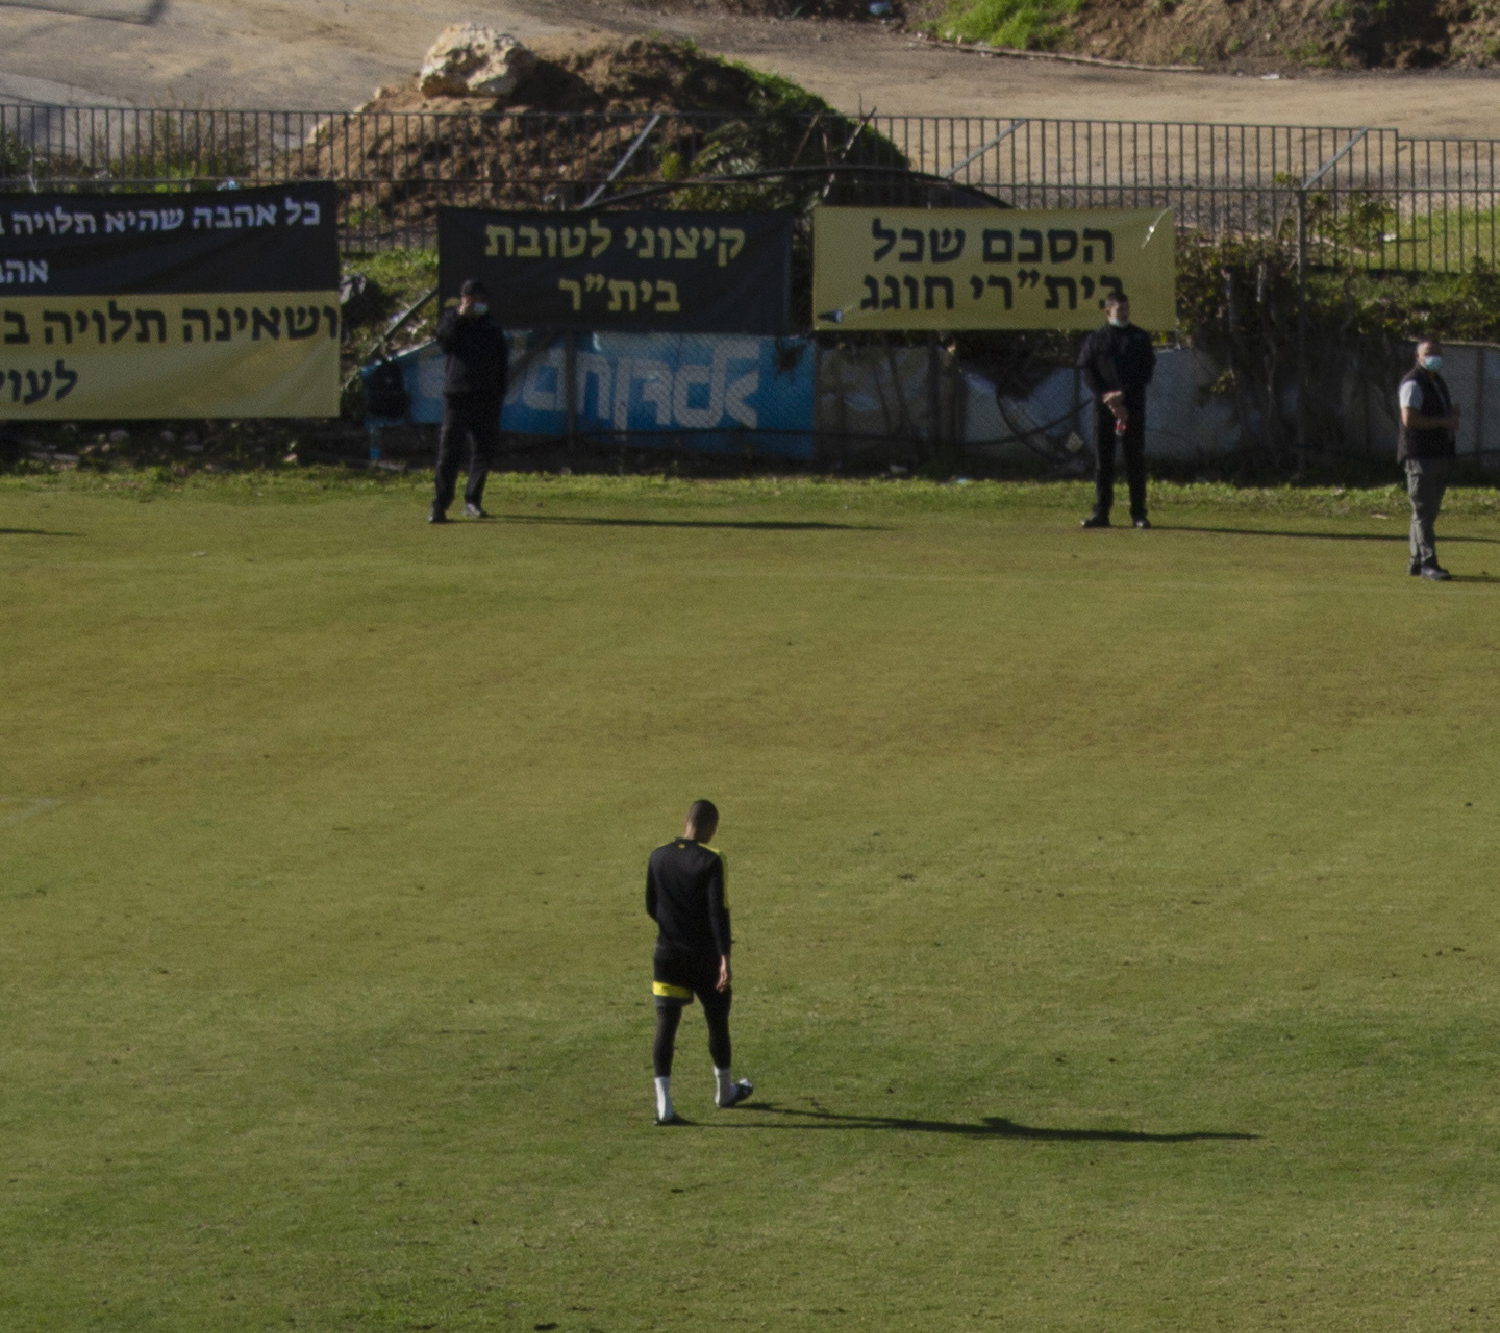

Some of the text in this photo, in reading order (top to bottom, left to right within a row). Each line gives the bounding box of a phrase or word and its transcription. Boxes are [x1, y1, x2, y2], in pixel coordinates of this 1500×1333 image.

[11, 205, 97, 235] תלויה
[104, 207, 185, 232] שהיא
[192, 203, 278, 229] אהבה
[285, 197, 321, 226] כל
[484, 217, 746, 267] קיצוני לטובת
[871, 218, 1115, 263] הסכם שכל
[558, 272, 681, 312] בית"ר
[860, 274, 955, 310] חוגג
[43, 300, 167, 345] תלויה
[180, 304, 339, 342] ושאינה
